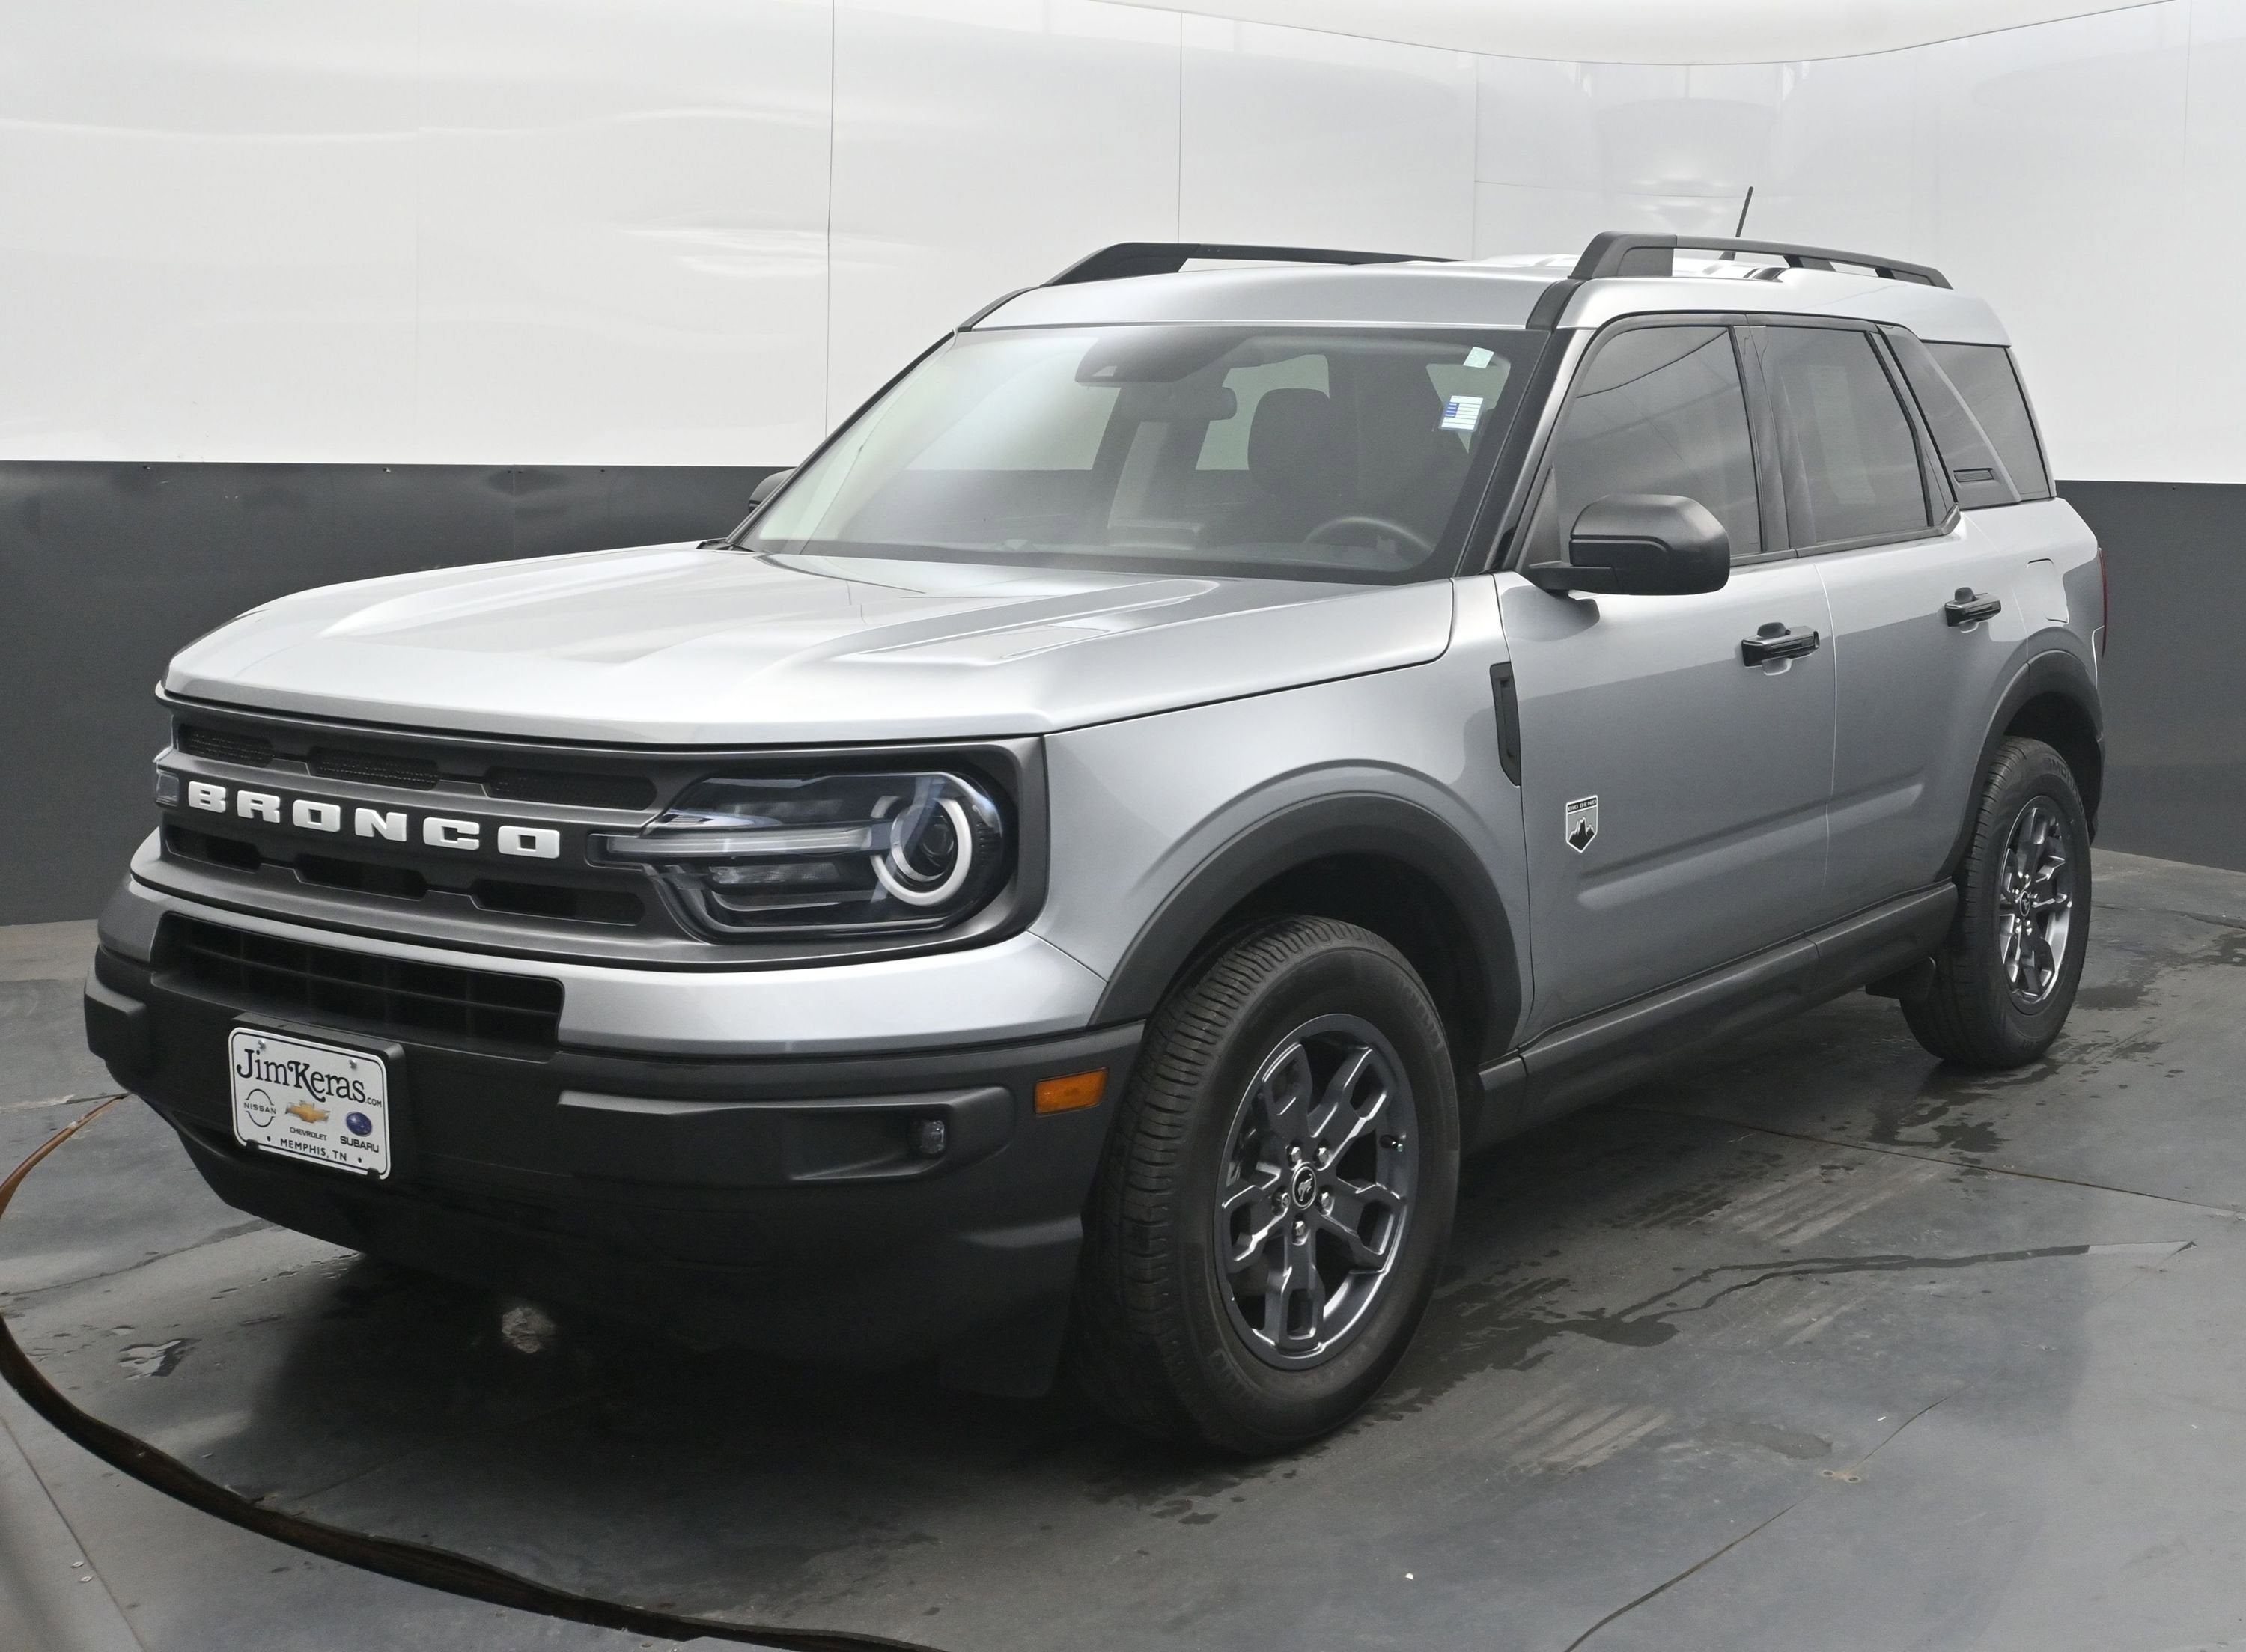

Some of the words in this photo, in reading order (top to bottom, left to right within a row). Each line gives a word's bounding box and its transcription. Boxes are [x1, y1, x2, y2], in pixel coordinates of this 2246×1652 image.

[1579, 799, 1597, 808] BEND
[188, 780, 561, 859] BRONCO
[243, 1102, 276, 1115] NISSAN
[290, 1127, 327, 1141] CHEVROLET
[280, 1137, 329, 1159] MEMPHIS,
[332, 1150, 347, 1162] TN
[340, 1136, 380, 1153] SUBARU
